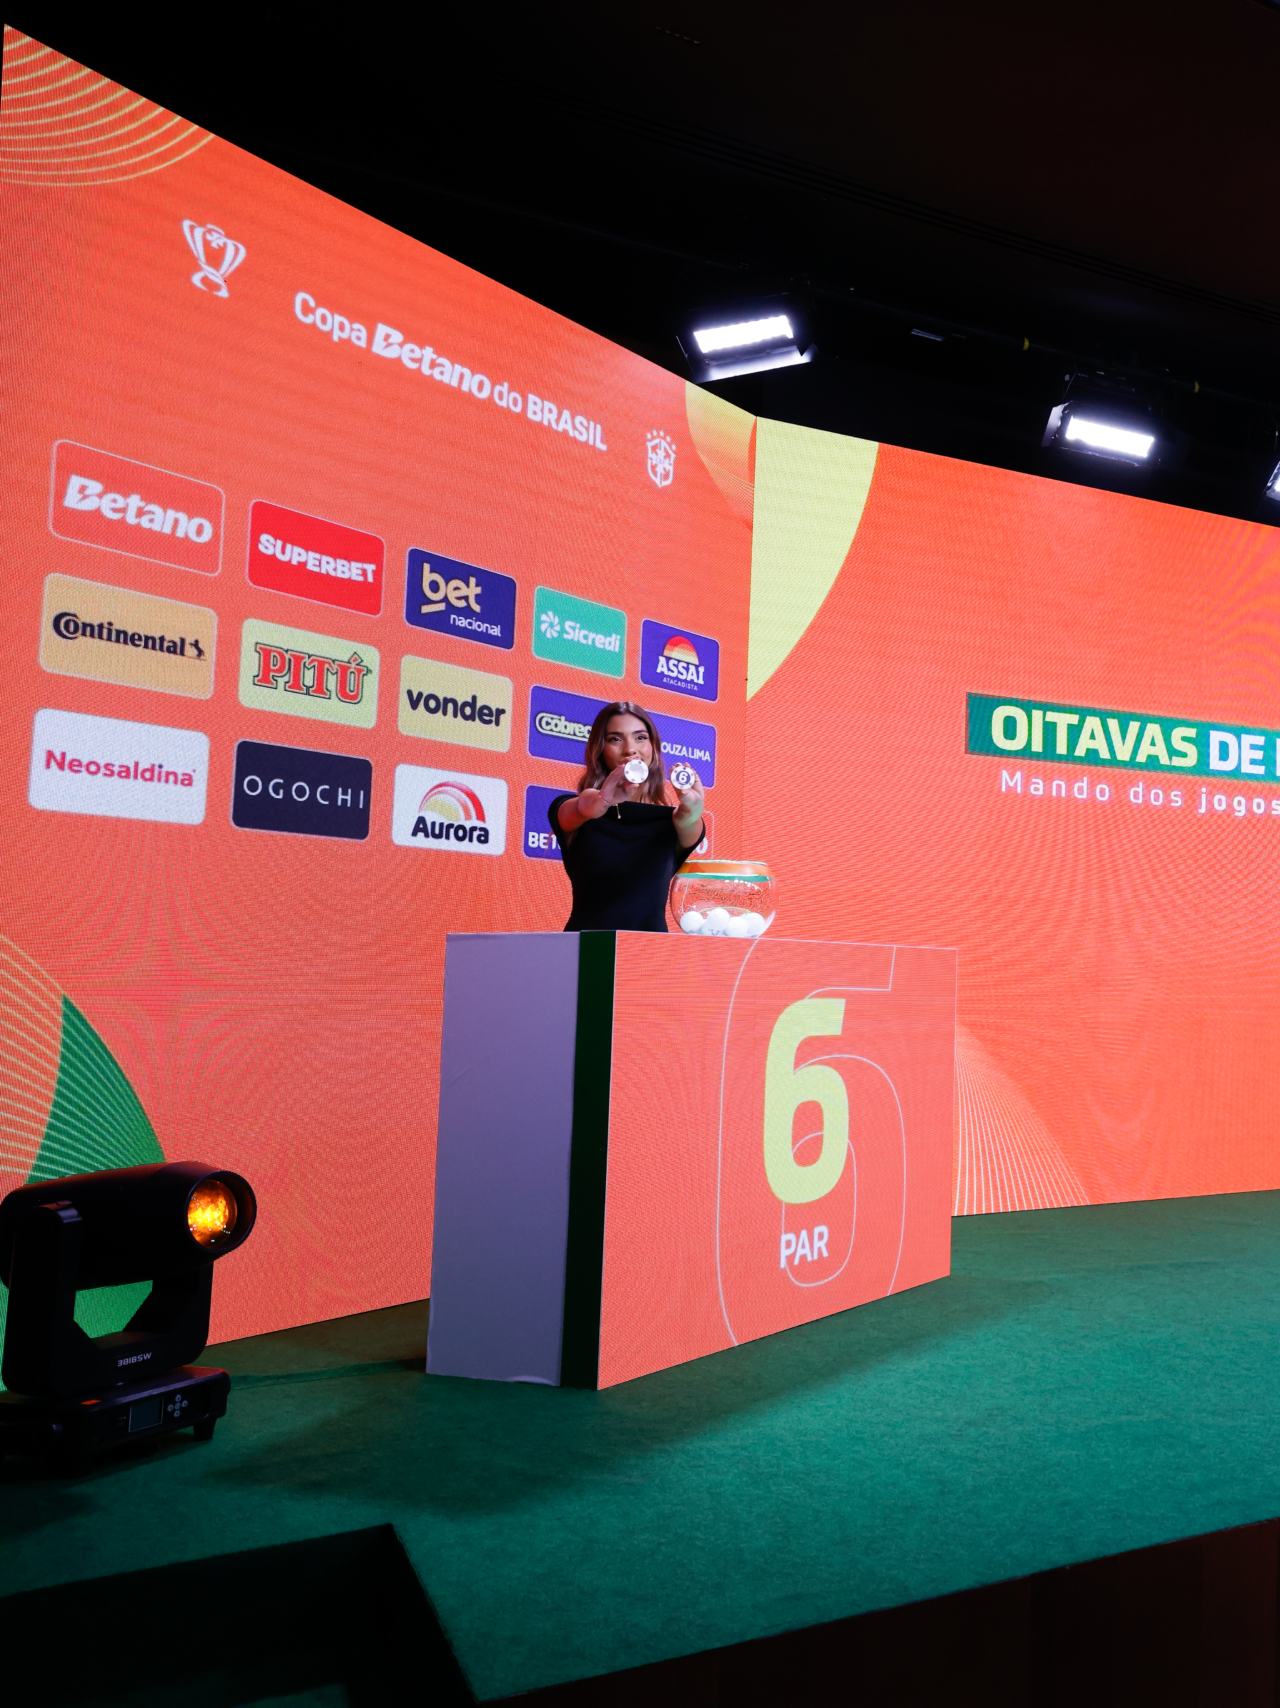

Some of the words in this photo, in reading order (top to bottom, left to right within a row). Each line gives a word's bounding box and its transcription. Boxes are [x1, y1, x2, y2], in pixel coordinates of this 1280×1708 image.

[294, 291, 368, 348] Copa
[371, 322, 492, 400] Betano
[493, 381, 523, 414] do
[527, 393, 607, 451] BRASIL
[63, 474, 213, 543] Betano
[258, 533, 376, 583] SUPERBET
[421, 562, 482, 613] bet
[52, 611, 187, 657] Continental
[450, 614, 502, 637] nacional
[563, 620, 621, 652] Sicredi
[253, 642, 370, 705] PITÚ
[662, 677, 698, 691] ATACADISTA
[406, 689, 506, 727] vonder
[538, 714, 592, 740] cobrec
[660, 742, 688, 758] OUZA
[688, 747, 711, 762] LIMA
[991, 705, 1199, 768] OITAVAS
[1208, 730, 1265, 775] DE
[44, 750, 195, 787] Neosaldina
[679, 771, 688, 784] 6
[243, 775, 365, 809] OGOCHI
[1001, 769, 1111, 802] Mando
[1130, 781, 1183, 807] dos
[411, 816, 490, 845] Aurora
[763, 998, 849, 1204] 6
[779, 1225, 829, 1269] PAR
